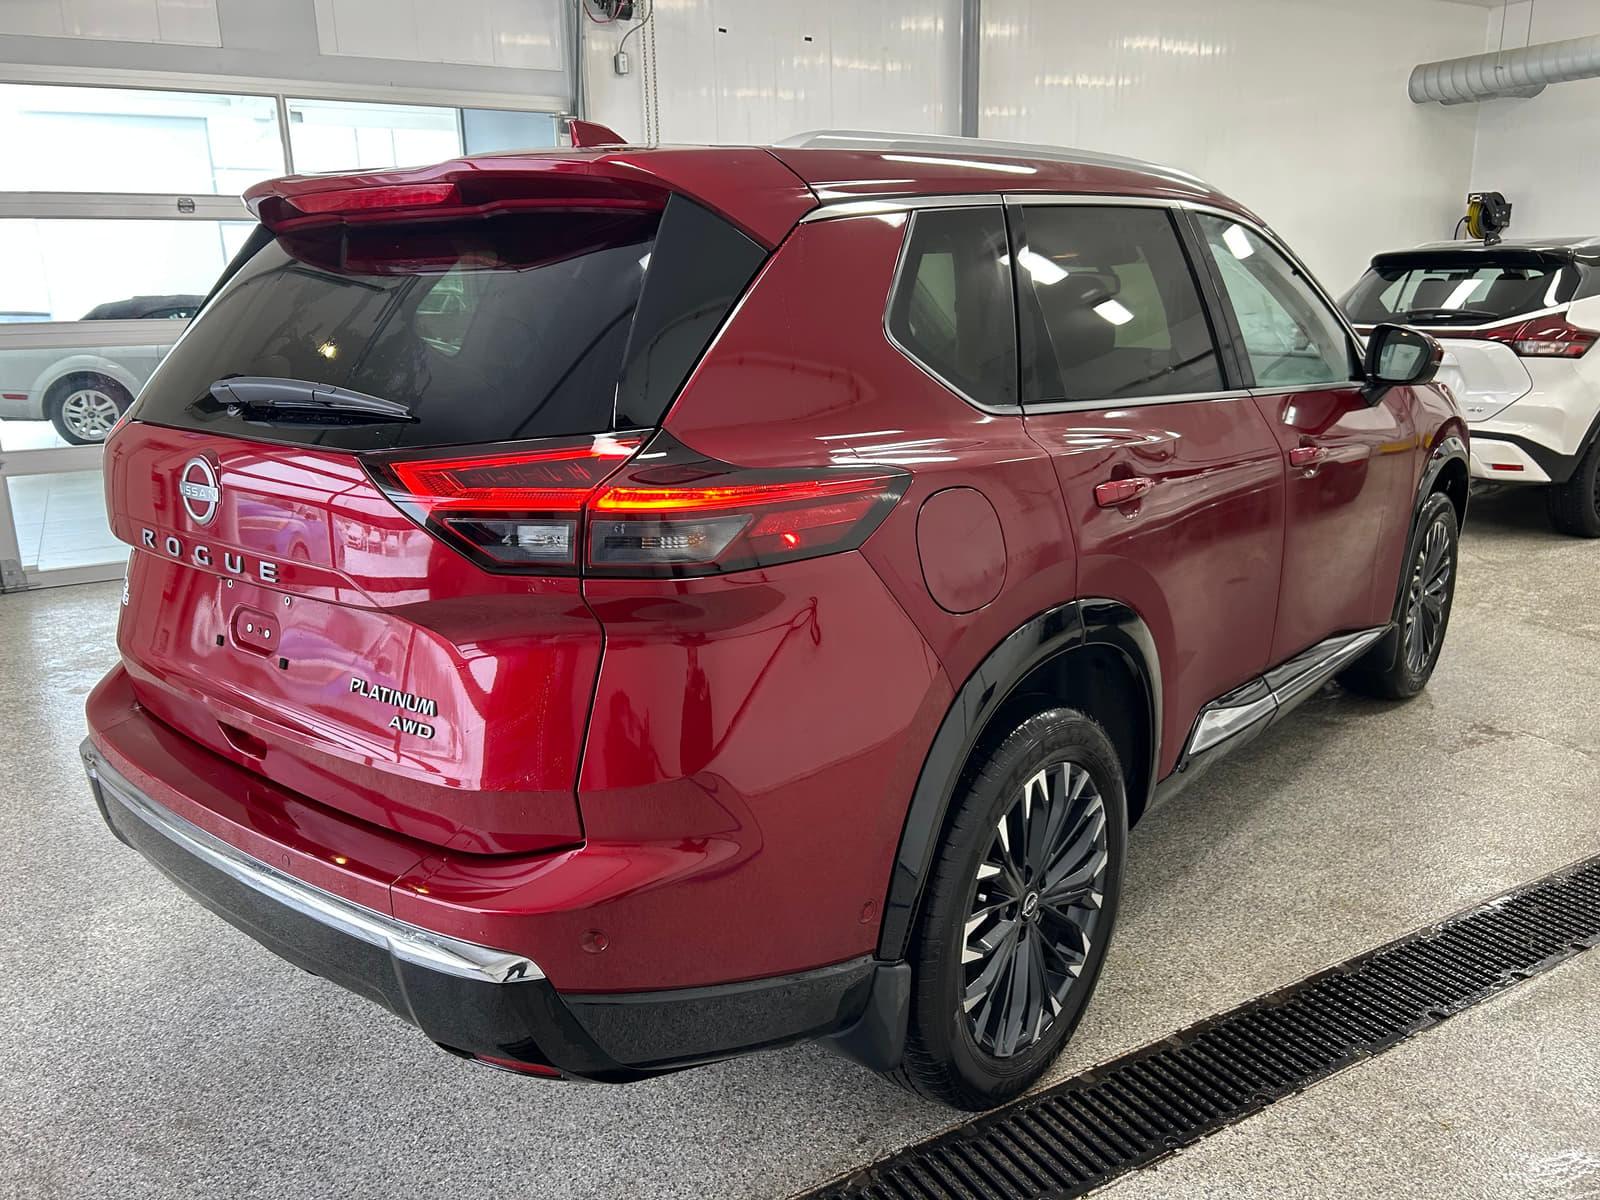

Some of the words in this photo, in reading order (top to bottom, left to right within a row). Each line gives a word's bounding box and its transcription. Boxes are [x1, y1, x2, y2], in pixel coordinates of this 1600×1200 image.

[141, 527, 280, 583] ROGUE
[349, 676, 438, 718] PLATINUM
[388, 714, 435, 740] AWD
